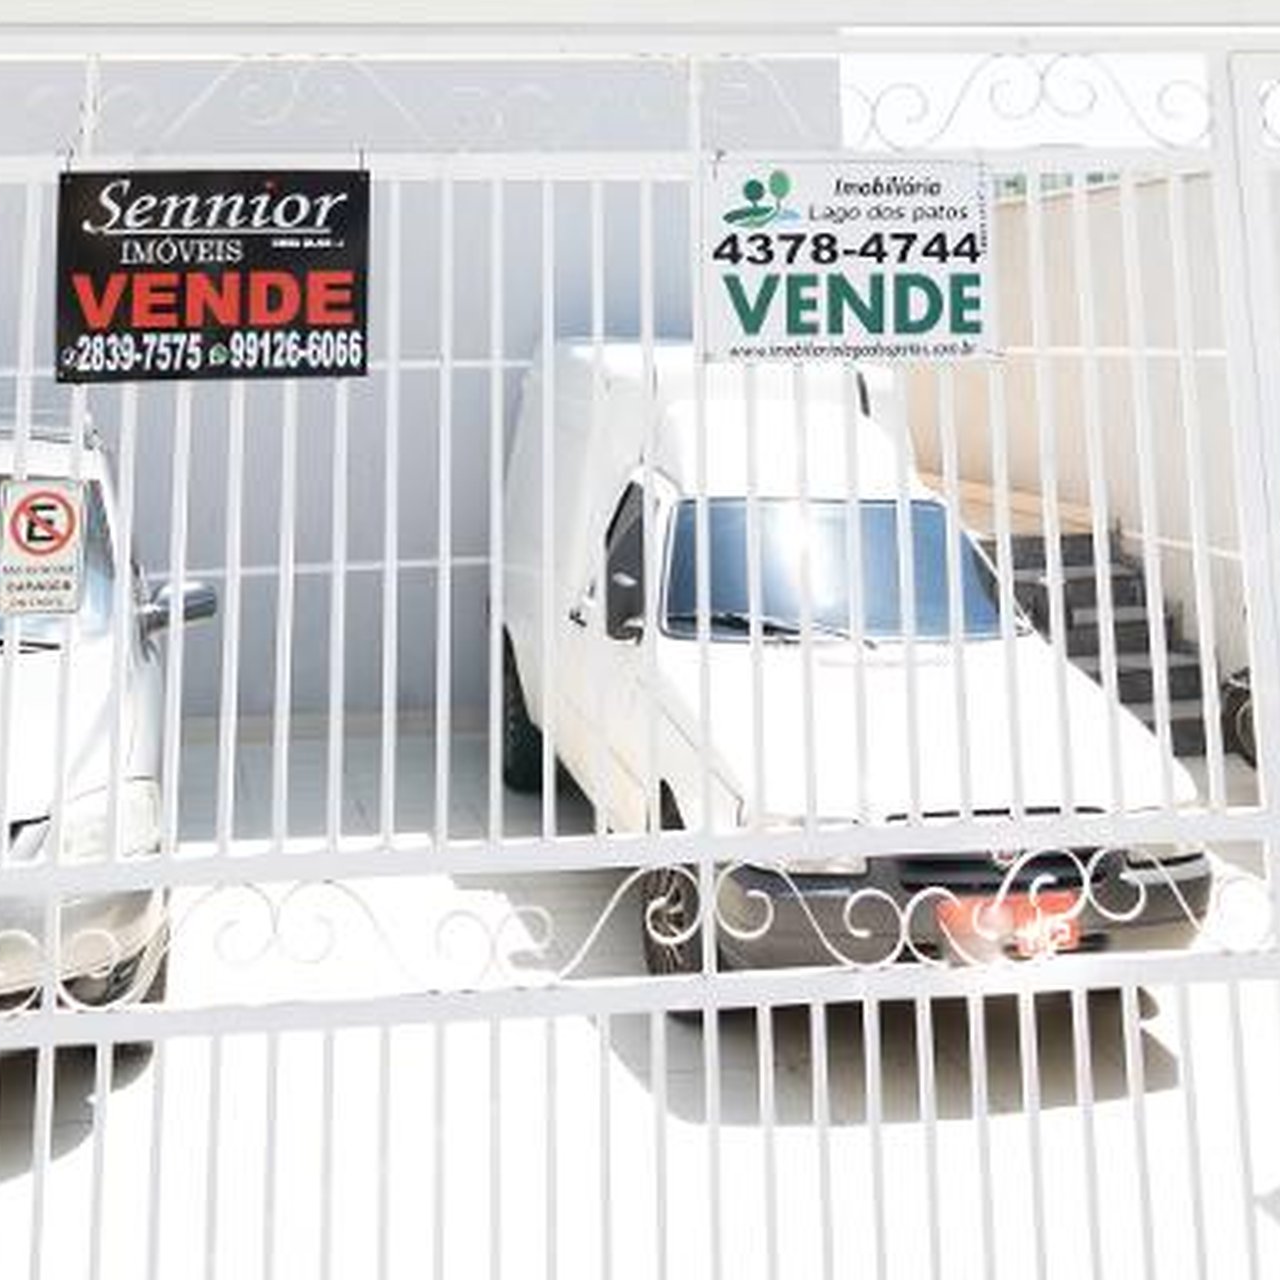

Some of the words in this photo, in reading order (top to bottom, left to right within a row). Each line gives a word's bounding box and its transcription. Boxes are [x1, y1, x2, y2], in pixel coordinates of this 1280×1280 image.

[82, 178, 348, 232] Sennior
[808, 205, 860, 224] Lago
[866, 203, 905, 222] dos
[712, 232, 981, 265] 4378-4744
[72, 272, 354, 330] VENDE
[722, 272, 983, 336] VENDE
[77, 334, 203, 371] 2839-7575
[229, 331, 363, 368] 99126-6066
